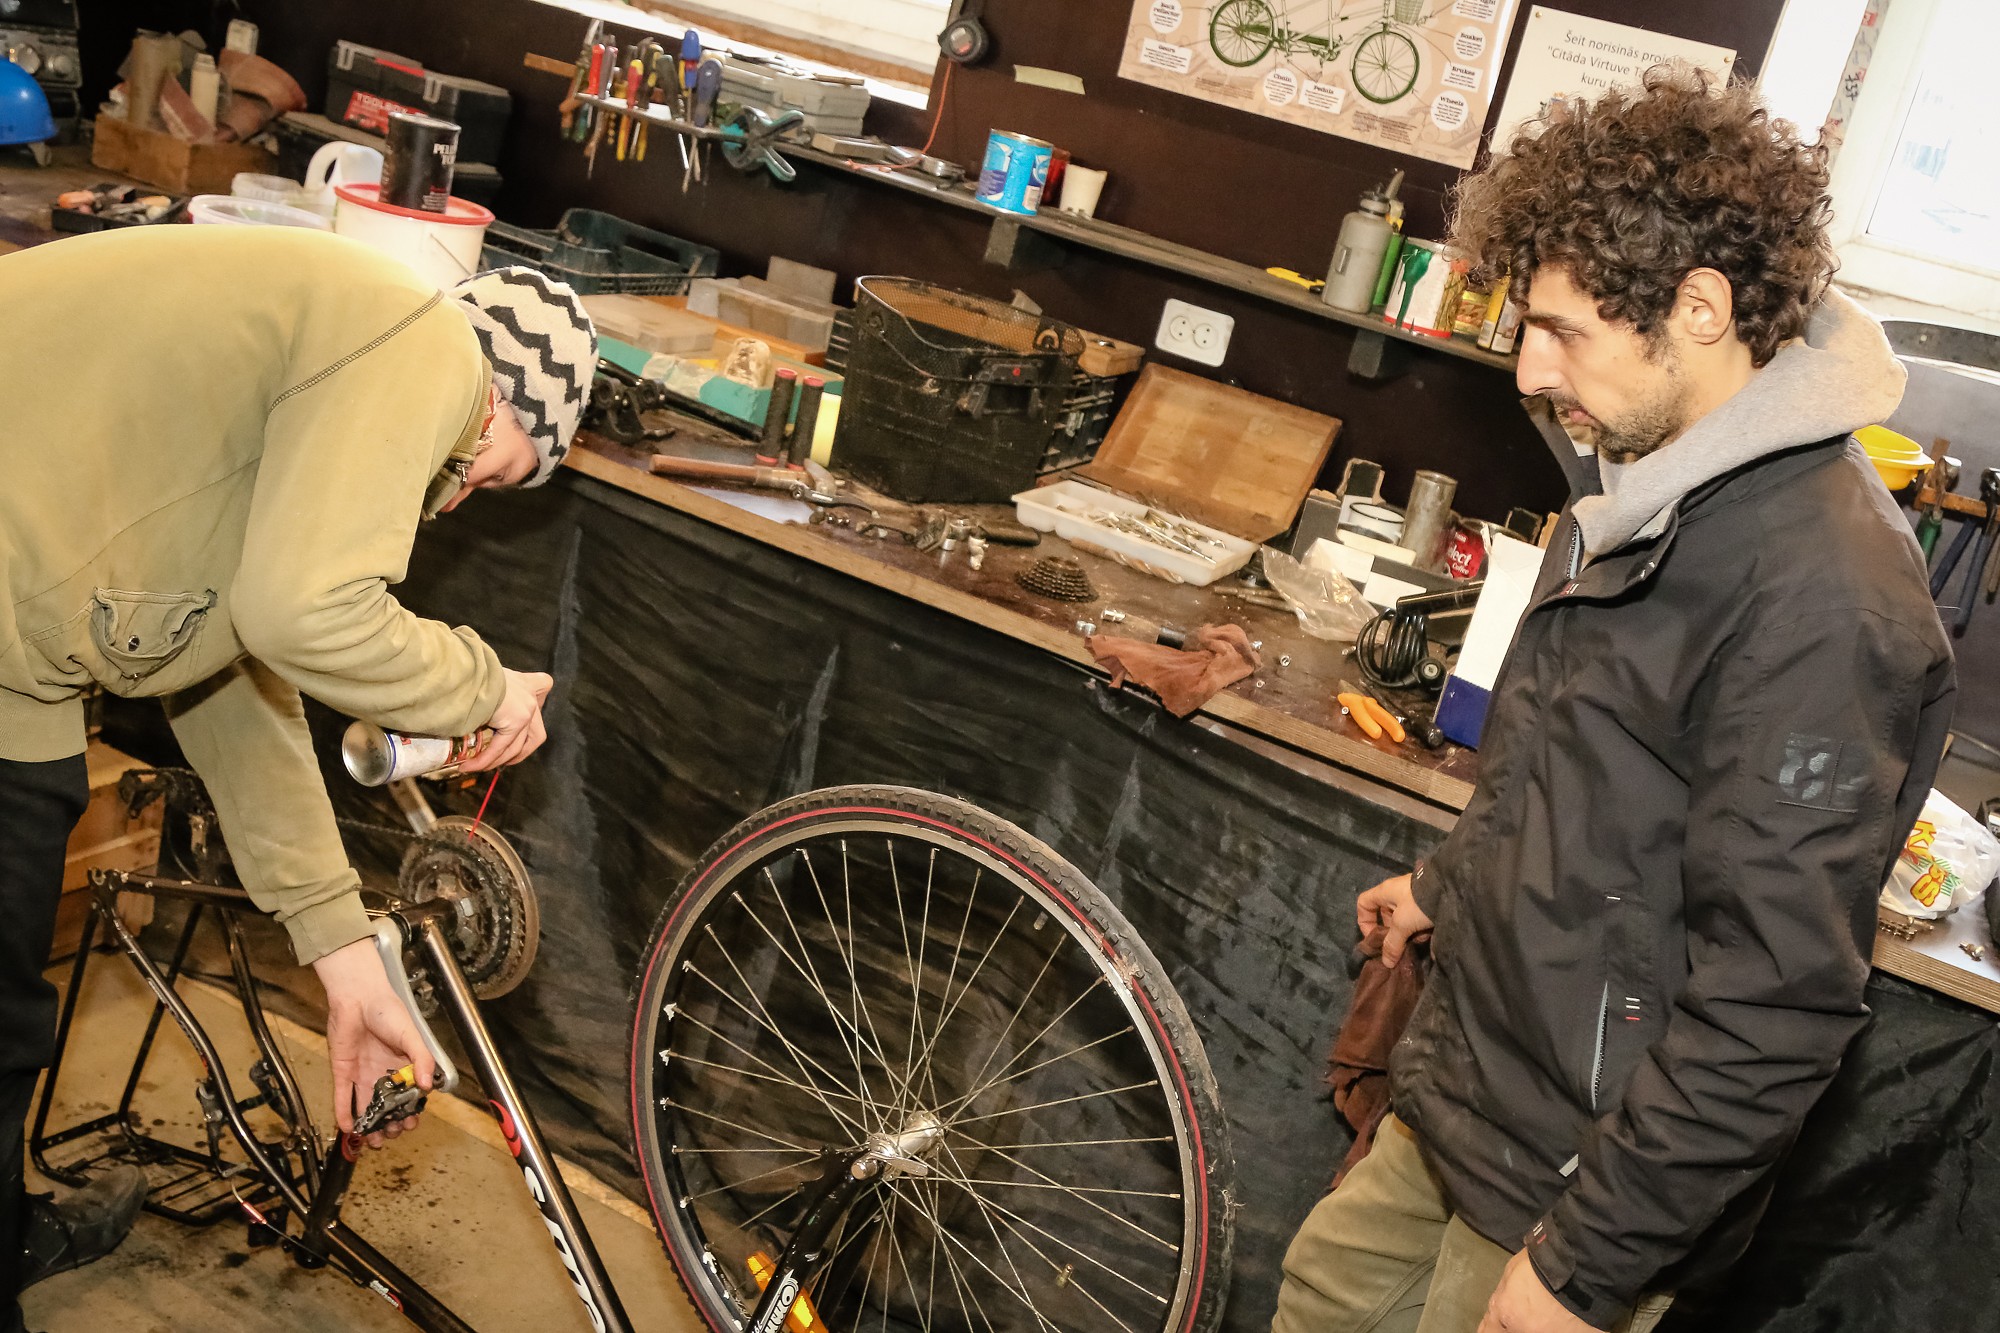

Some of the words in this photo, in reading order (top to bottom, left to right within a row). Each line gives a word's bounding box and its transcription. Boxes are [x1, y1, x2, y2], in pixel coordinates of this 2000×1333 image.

[1460, 33, 1483, 43] Basket
[1564, 29, 1586, 46] Šeit
[1588, 38, 1639, 59] norisinās
[1590, 56, 1630, 75] Virtuve
[1452, 66, 1475, 76] Brakes
[1273, 73, 1292, 83] Chain
[1581, 72, 1606, 88] kuru
[1313, 85, 1334, 95] Pedals
[1440, 96, 1464, 107] Wheels
